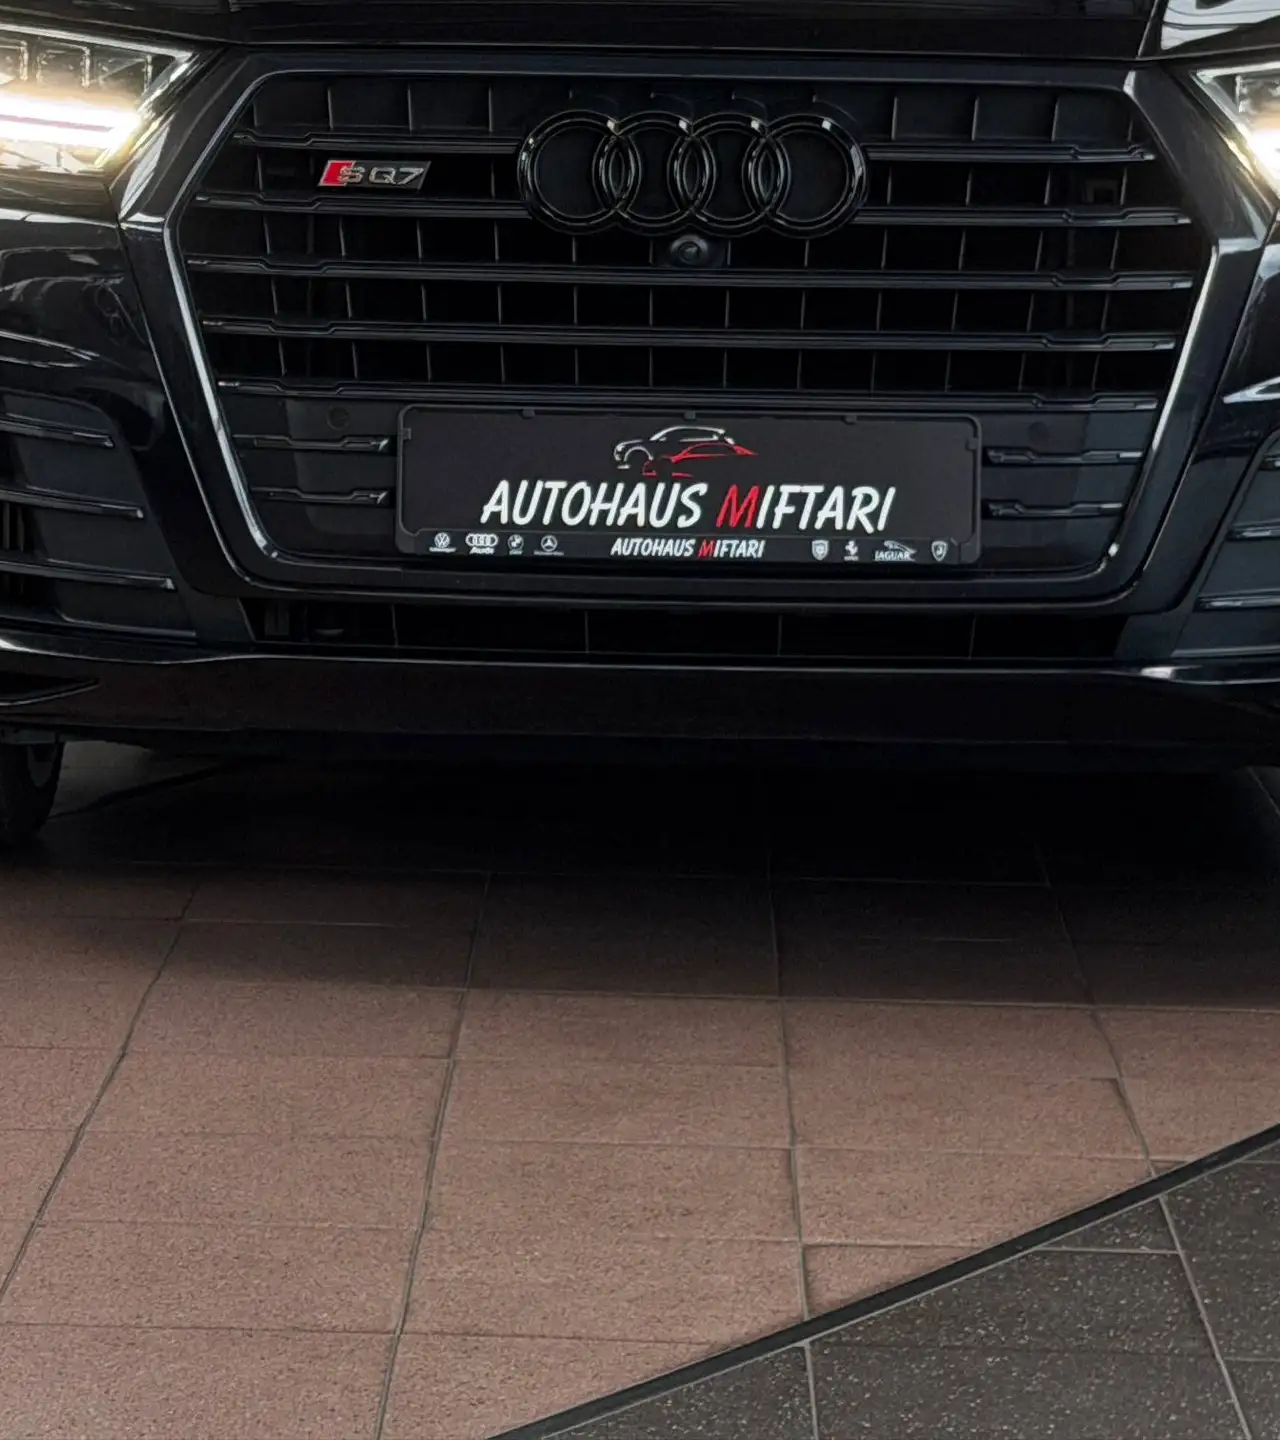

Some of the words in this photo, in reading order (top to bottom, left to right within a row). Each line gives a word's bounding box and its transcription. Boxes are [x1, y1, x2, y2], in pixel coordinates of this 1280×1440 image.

[338, 165, 425, 185] SQ7
[480, 479, 710, 529] AUTOHAUS
[716, 483, 896, 534] MIFTARI
[610, 537, 696, 558] AUTOHAUS
[698, 538, 766, 559] MIFTARI
[874, 550, 911, 561] JAGUAR
